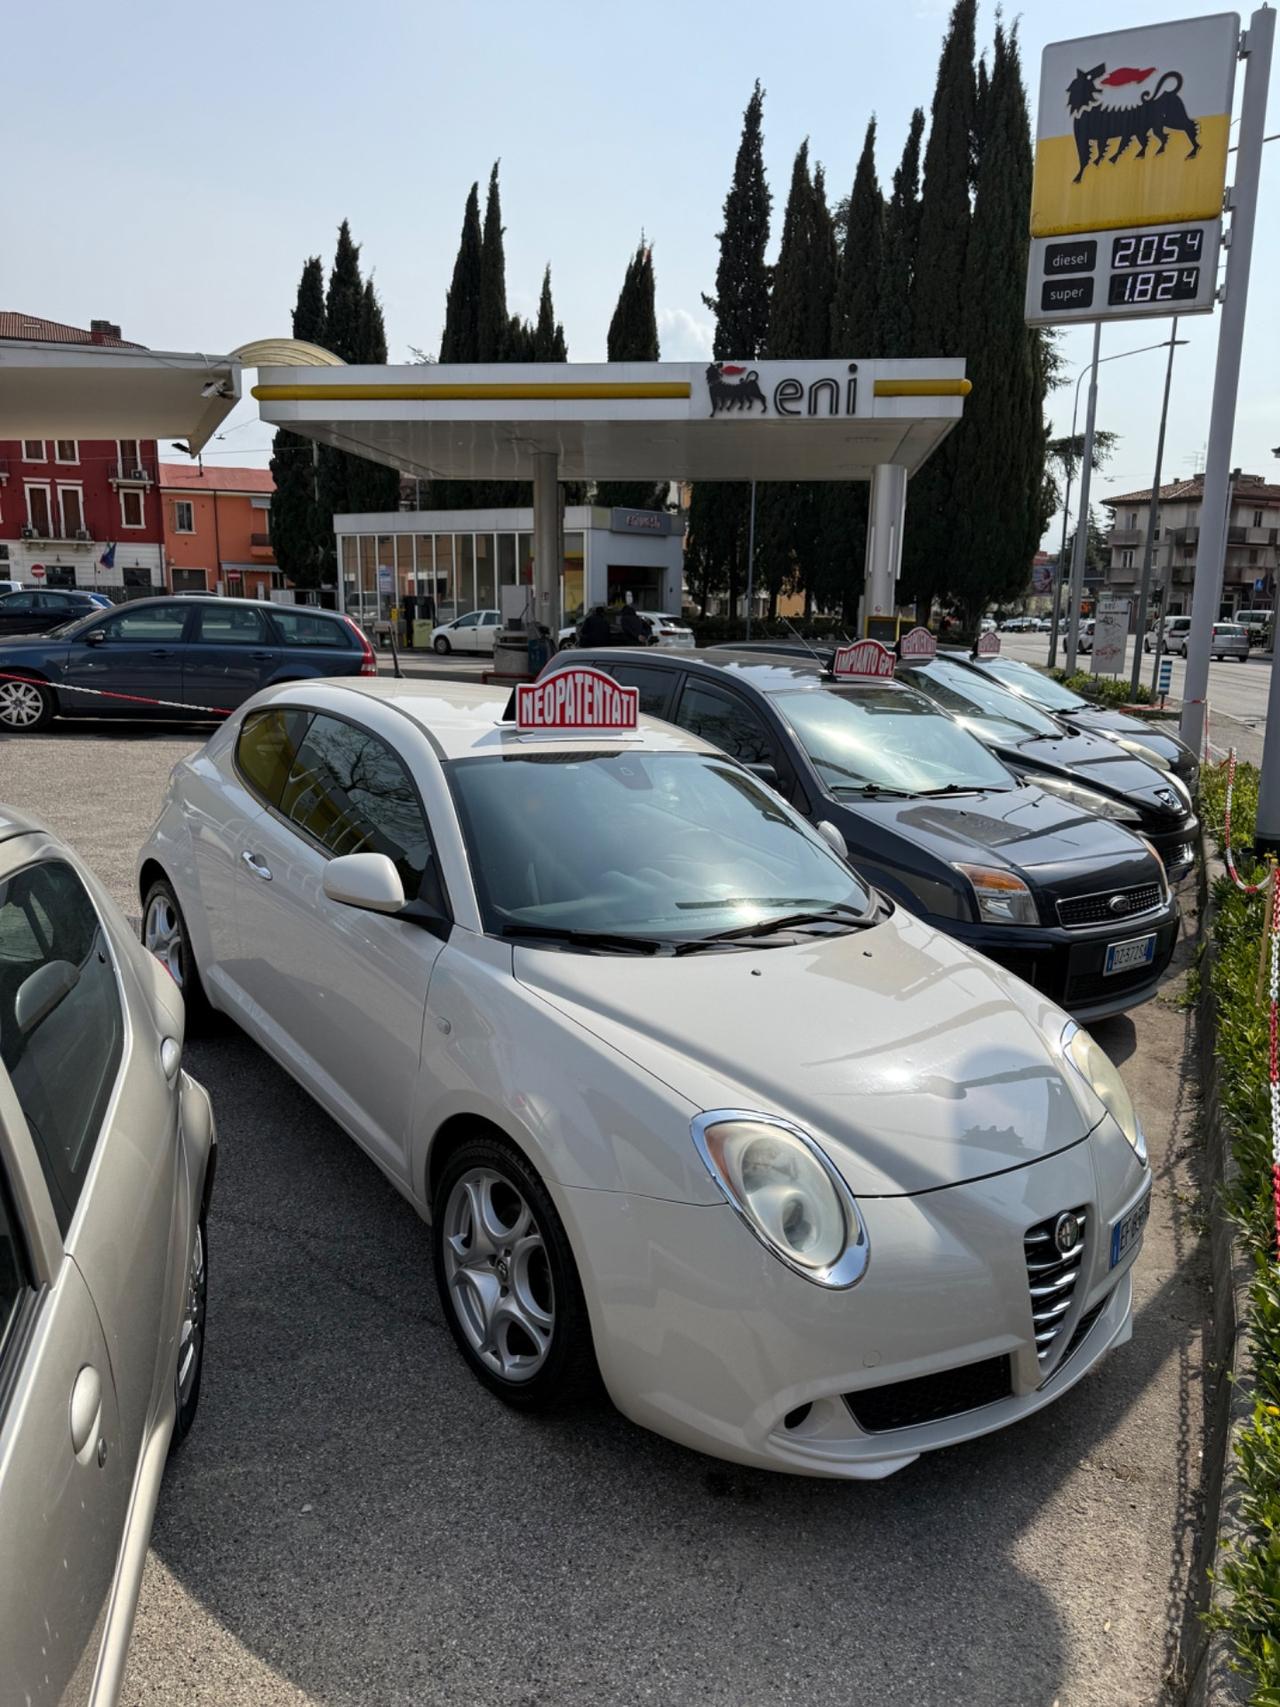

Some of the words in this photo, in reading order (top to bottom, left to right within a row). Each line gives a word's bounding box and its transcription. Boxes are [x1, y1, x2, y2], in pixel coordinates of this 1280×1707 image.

[1052, 251, 1088, 267] diesel
[1050, 288, 1084, 301] super
[774, 363, 859, 416] eni
[837, 644, 879, 674] IMPIANTO
[878, 652, 893, 676] GPL
[521, 672, 636, 726] NEOPATENTATI
